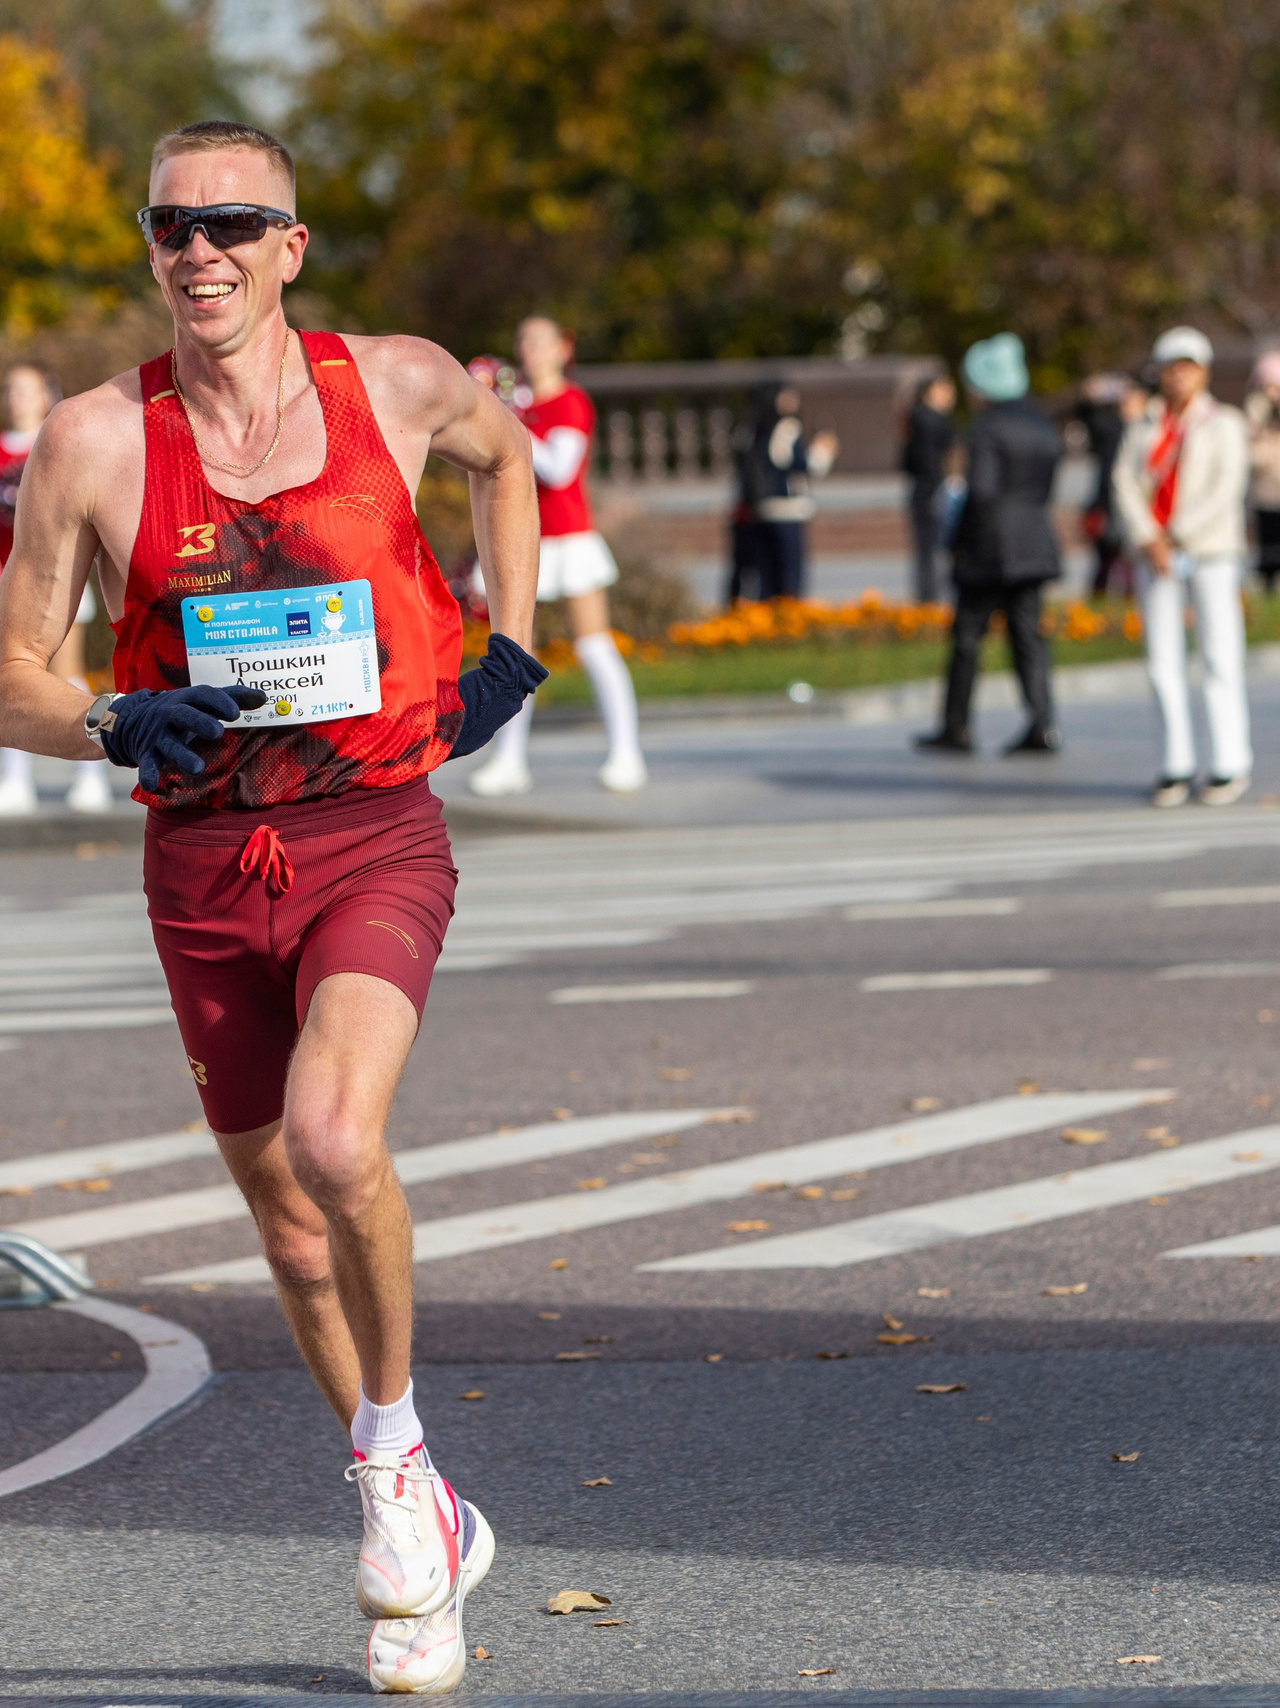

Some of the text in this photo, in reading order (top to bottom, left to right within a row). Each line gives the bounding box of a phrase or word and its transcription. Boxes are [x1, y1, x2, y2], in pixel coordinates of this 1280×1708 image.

[168, 570, 231, 589] MAXIMILIAN
[211, 618, 261, 628] ПОЛУМАРАФОН
[289, 618, 308, 626] ЭЛИТА
[205, 625, 278, 640] МОЯ СТОЛИЦА
[225, 653, 326, 678] Трошкин
[361, 657, 372, 693] МОСКВА
